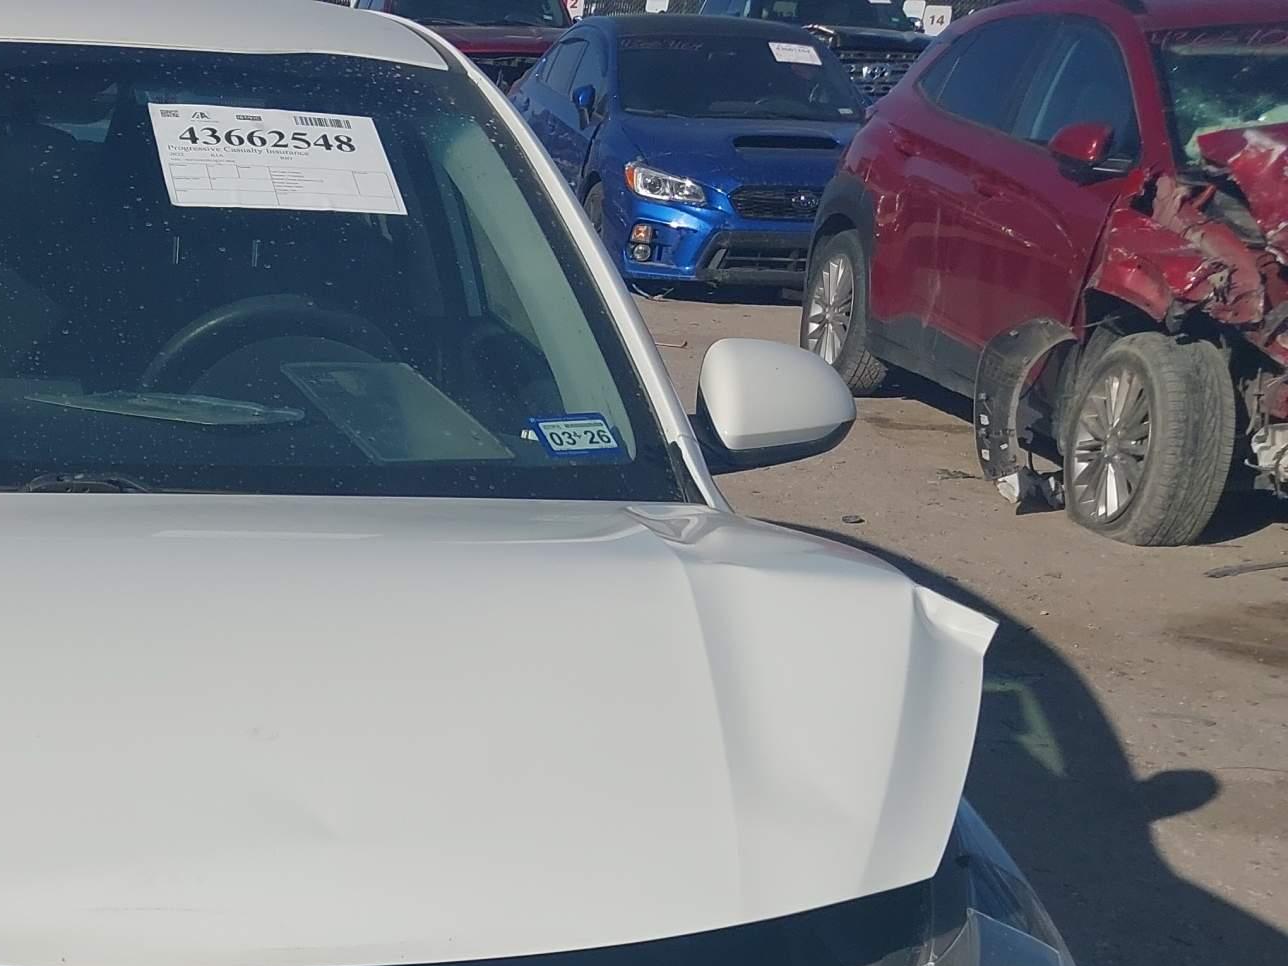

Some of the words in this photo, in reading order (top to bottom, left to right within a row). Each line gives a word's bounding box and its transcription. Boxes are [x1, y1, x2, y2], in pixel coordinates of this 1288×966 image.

[929, 15, 945, 25] 14
[178, 126, 356, 153] 43662548
[168, 144, 220, 153] Progressive
[224, 146, 263, 155] Casualty
[266, 148, 309, 156] Insurance
[550, 431, 577, 446] 03
[583, 430, 611, 445] 26
